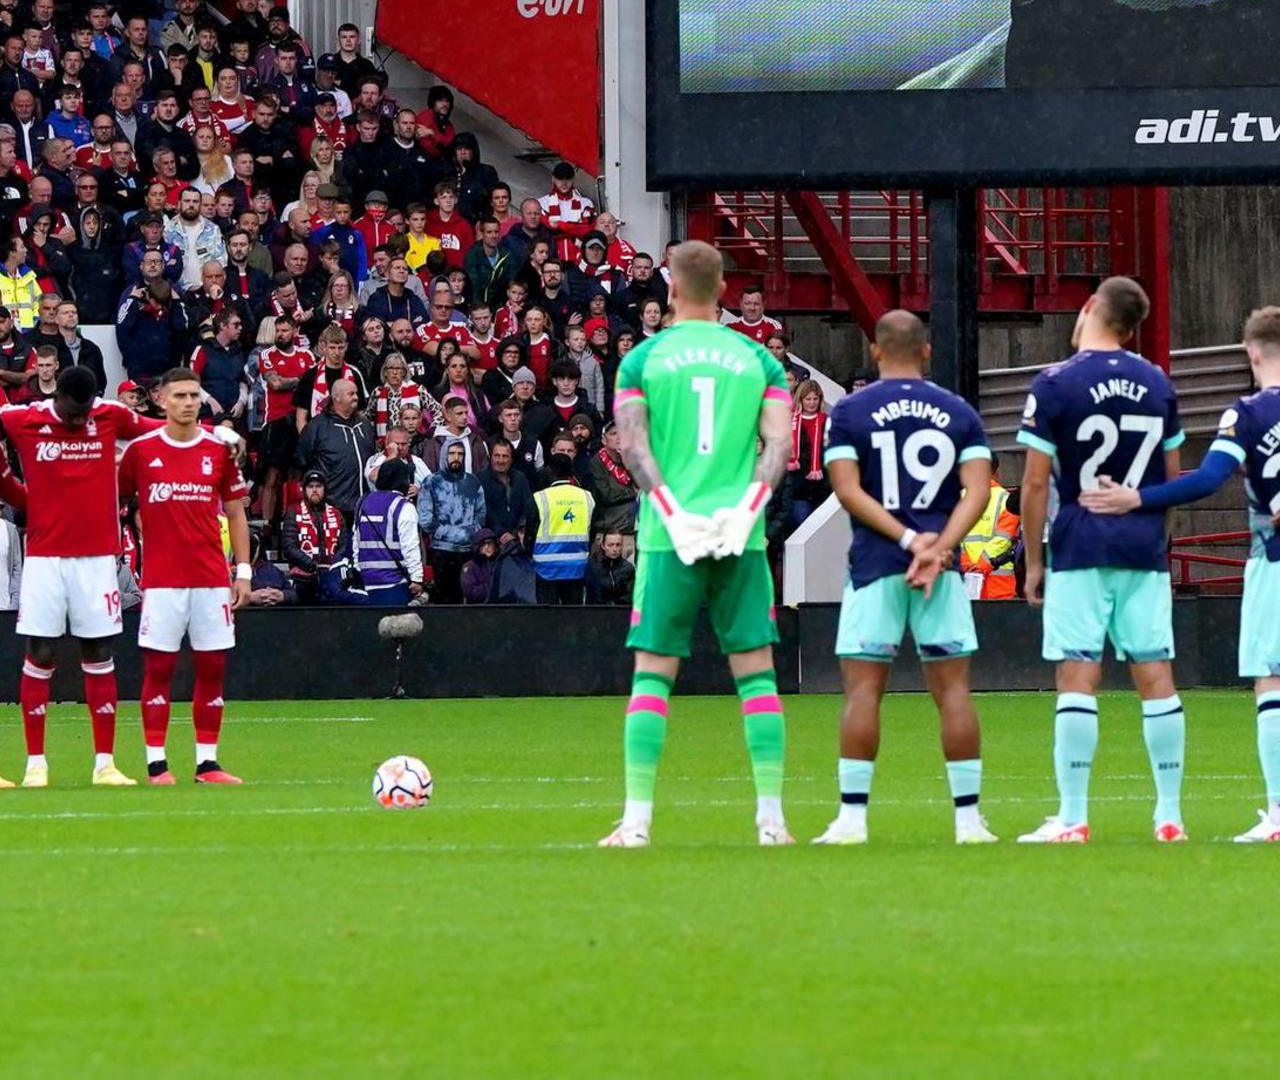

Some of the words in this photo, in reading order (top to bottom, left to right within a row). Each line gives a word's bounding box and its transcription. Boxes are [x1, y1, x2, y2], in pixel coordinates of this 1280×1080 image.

[664, 353, 746, 376] FLEKKEN
[1090, 379, 1147, 403] JANELT
[692, 376, 715, 455] 1
[872, 399, 950, 428] MBEUMO
[1076, 414, 1163, 490] 27
[871, 428, 956, 510] 19
[563, 506, 576, 524] 4
[104, 590, 122, 617] 19
